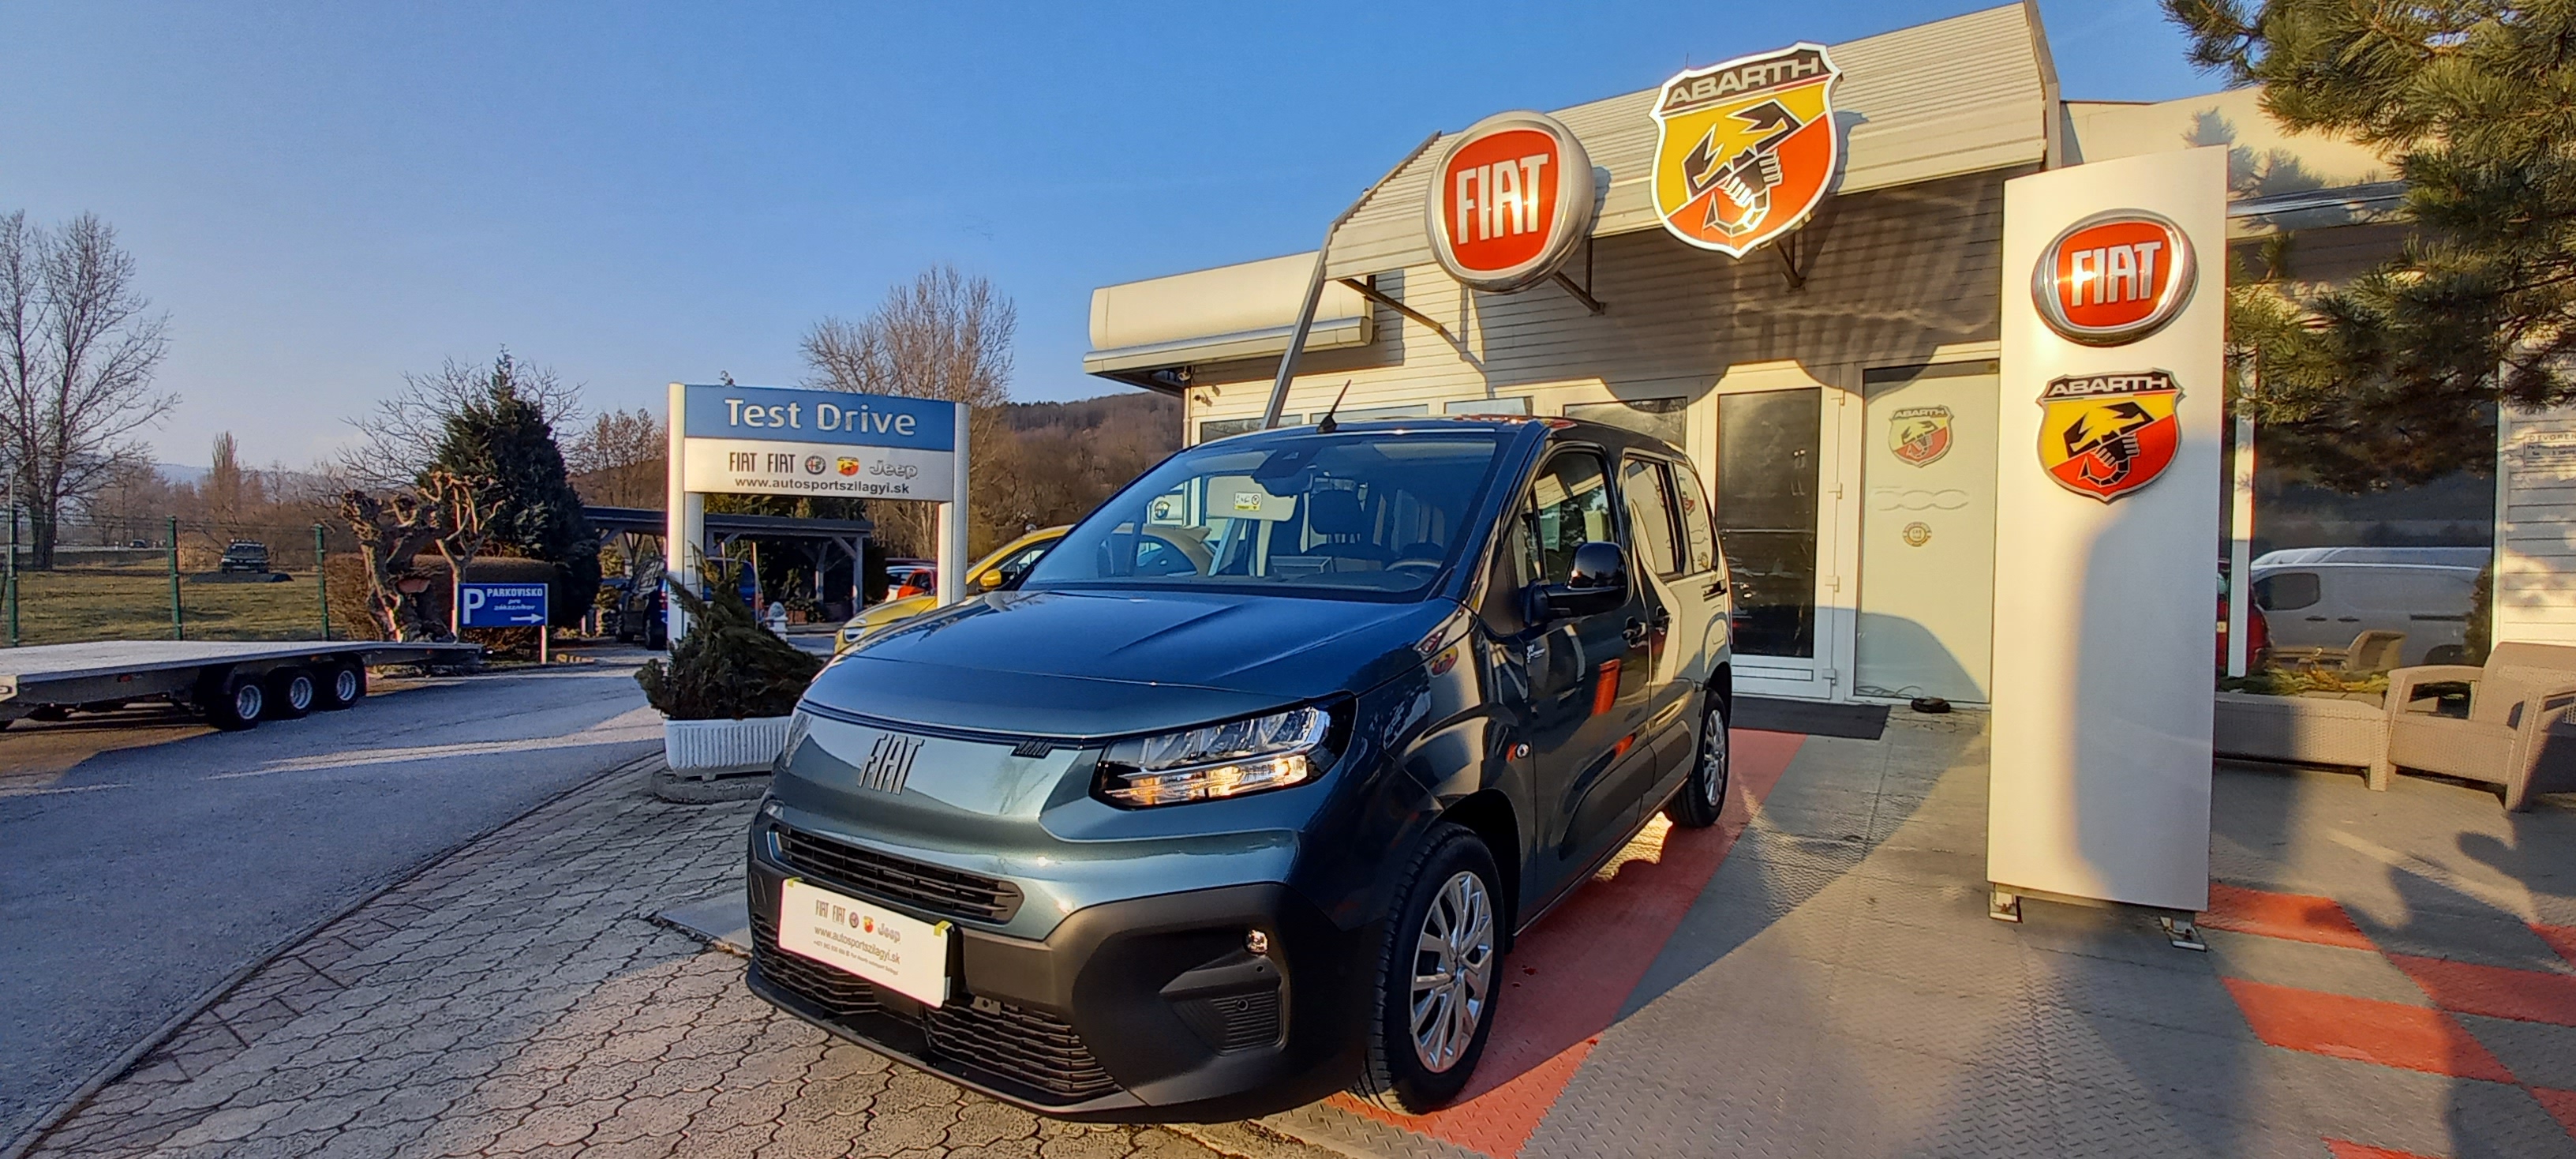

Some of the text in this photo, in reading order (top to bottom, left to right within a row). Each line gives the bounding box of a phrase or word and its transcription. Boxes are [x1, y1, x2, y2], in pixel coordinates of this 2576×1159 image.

[1666, 57, 1819, 107] ABARTH
[1455, 153, 1549, 245] FIAT
[2071, 241, 2162, 307] FIAT
[2051, 377, 2169, 395] ABARTH
[724, 399, 917, 437] Test Drive
[1894, 408, 1945, 418] ABARTH
[728, 452, 758, 472] FIAT
[767, 453, 796, 474] FIAT
[869, 459, 919, 480] Jeep
[734, 478, 911, 495] www.autosportszilagyi.sk
[463, 588, 485, 625] P
[486, 588, 543, 598] PARKOVISKO
[858, 733, 925, 795] FIAT
[815, 899, 901, 944] FIAT FIAT Jeep
